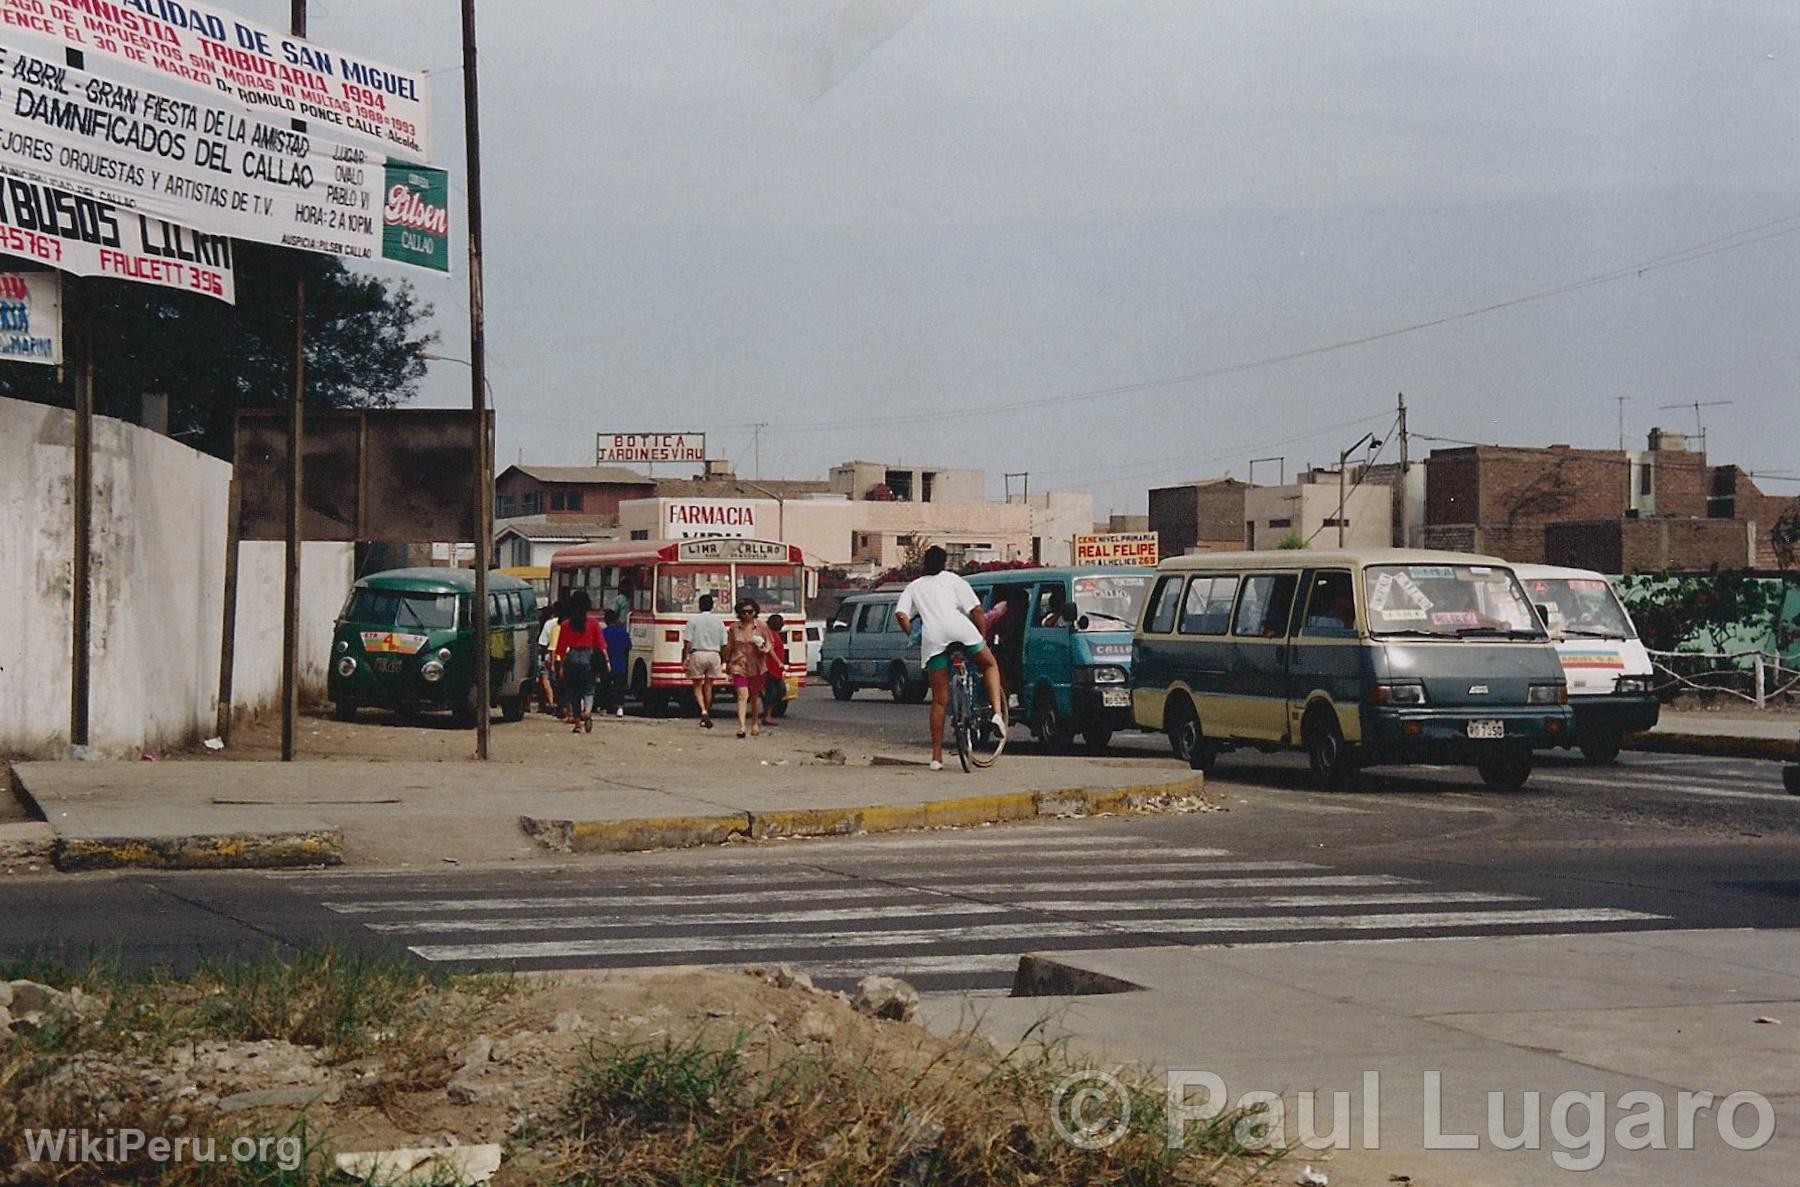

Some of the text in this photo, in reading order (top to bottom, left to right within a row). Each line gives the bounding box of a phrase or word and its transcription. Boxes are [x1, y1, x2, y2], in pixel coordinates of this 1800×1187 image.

[0, 9, 56, 35] ENCE
[64, 25, 87, 44] EL
[93, 35, 117, 53] 30
[124, 45, 147, 64] DE
[153, 56, 212, 86] MARZO
[238, 88, 295, 112] ROMULO
[300, 103, 343, 126] PONCE
[347, 116, 382, 138] CALLE
[5, 0, 45, 15] AGO
[51, 5, 77, 25] DE
[83, 16, 183, 61] IMPUESTOS
[190, 54, 217, 73] SIN
[222, 66, 275, 92] MORAS
[281, 83, 295, 98] NI
[301, 89, 351, 113] MULTAS
[61, 0, 386, 111] MNISTIA TRIBUTARIA 1994
[234, 22, 273, 57] DE
[281, 41, 334, 76] SAN
[340, 58, 420, 102] MIGUEL
[12, 55, 69, 95] ABRIL
[86, 78, 139, 115] GRAN
[143, 93, 197, 131] FIESTA
[204, 108, 225, 137] DE
[228, 114, 246, 144] LA
[251, 122, 310, 158] AMISTAD
[15, 87, 314, 190] DAMNIFICADOS DEL CALLAO
[60, 147, 145, 187] ORQUESTAS
[152, 170, 161, 191] Y
[165, 174, 228, 208] ARTISTAS
[231, 191, 249, 212] DE
[327, 185, 357, 207] PABLO
[335, 165, 364, 186] OVALO
[385, 185, 446, 233] Pilsen
[99, 248, 184, 285] FAUCETT
[190, 266, 223, 297] 395
[614, 435, 685, 448] BOTICA
[669, 505, 754, 526] FARMACIA
[688, 544, 717, 554] LIMA
[1078, 543, 1156, 558] REAL FELIPE
[1138, 556, 1156, 565] 269
